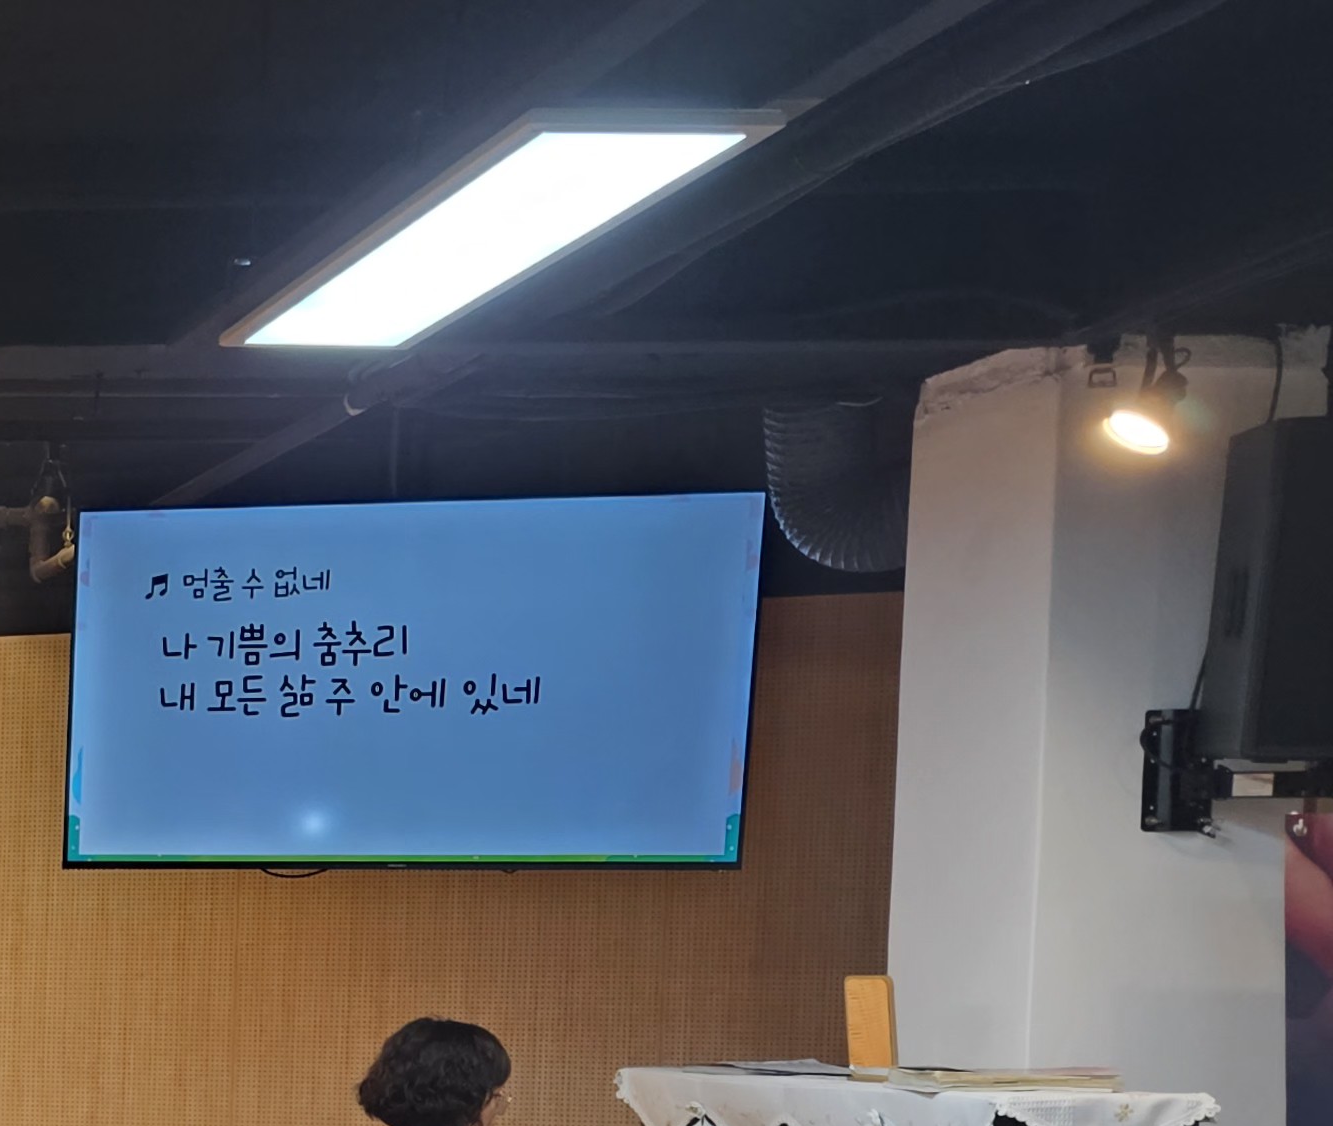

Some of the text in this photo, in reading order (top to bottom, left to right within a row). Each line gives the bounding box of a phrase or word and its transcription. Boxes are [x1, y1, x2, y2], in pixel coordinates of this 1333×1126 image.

[182, 566, 331, 602] 멈출 수 없네
[162, 620, 408, 667] 나 기쁨의 춤추리
[159, 673, 541, 718] 내 모든 삶 주 안에 있네
